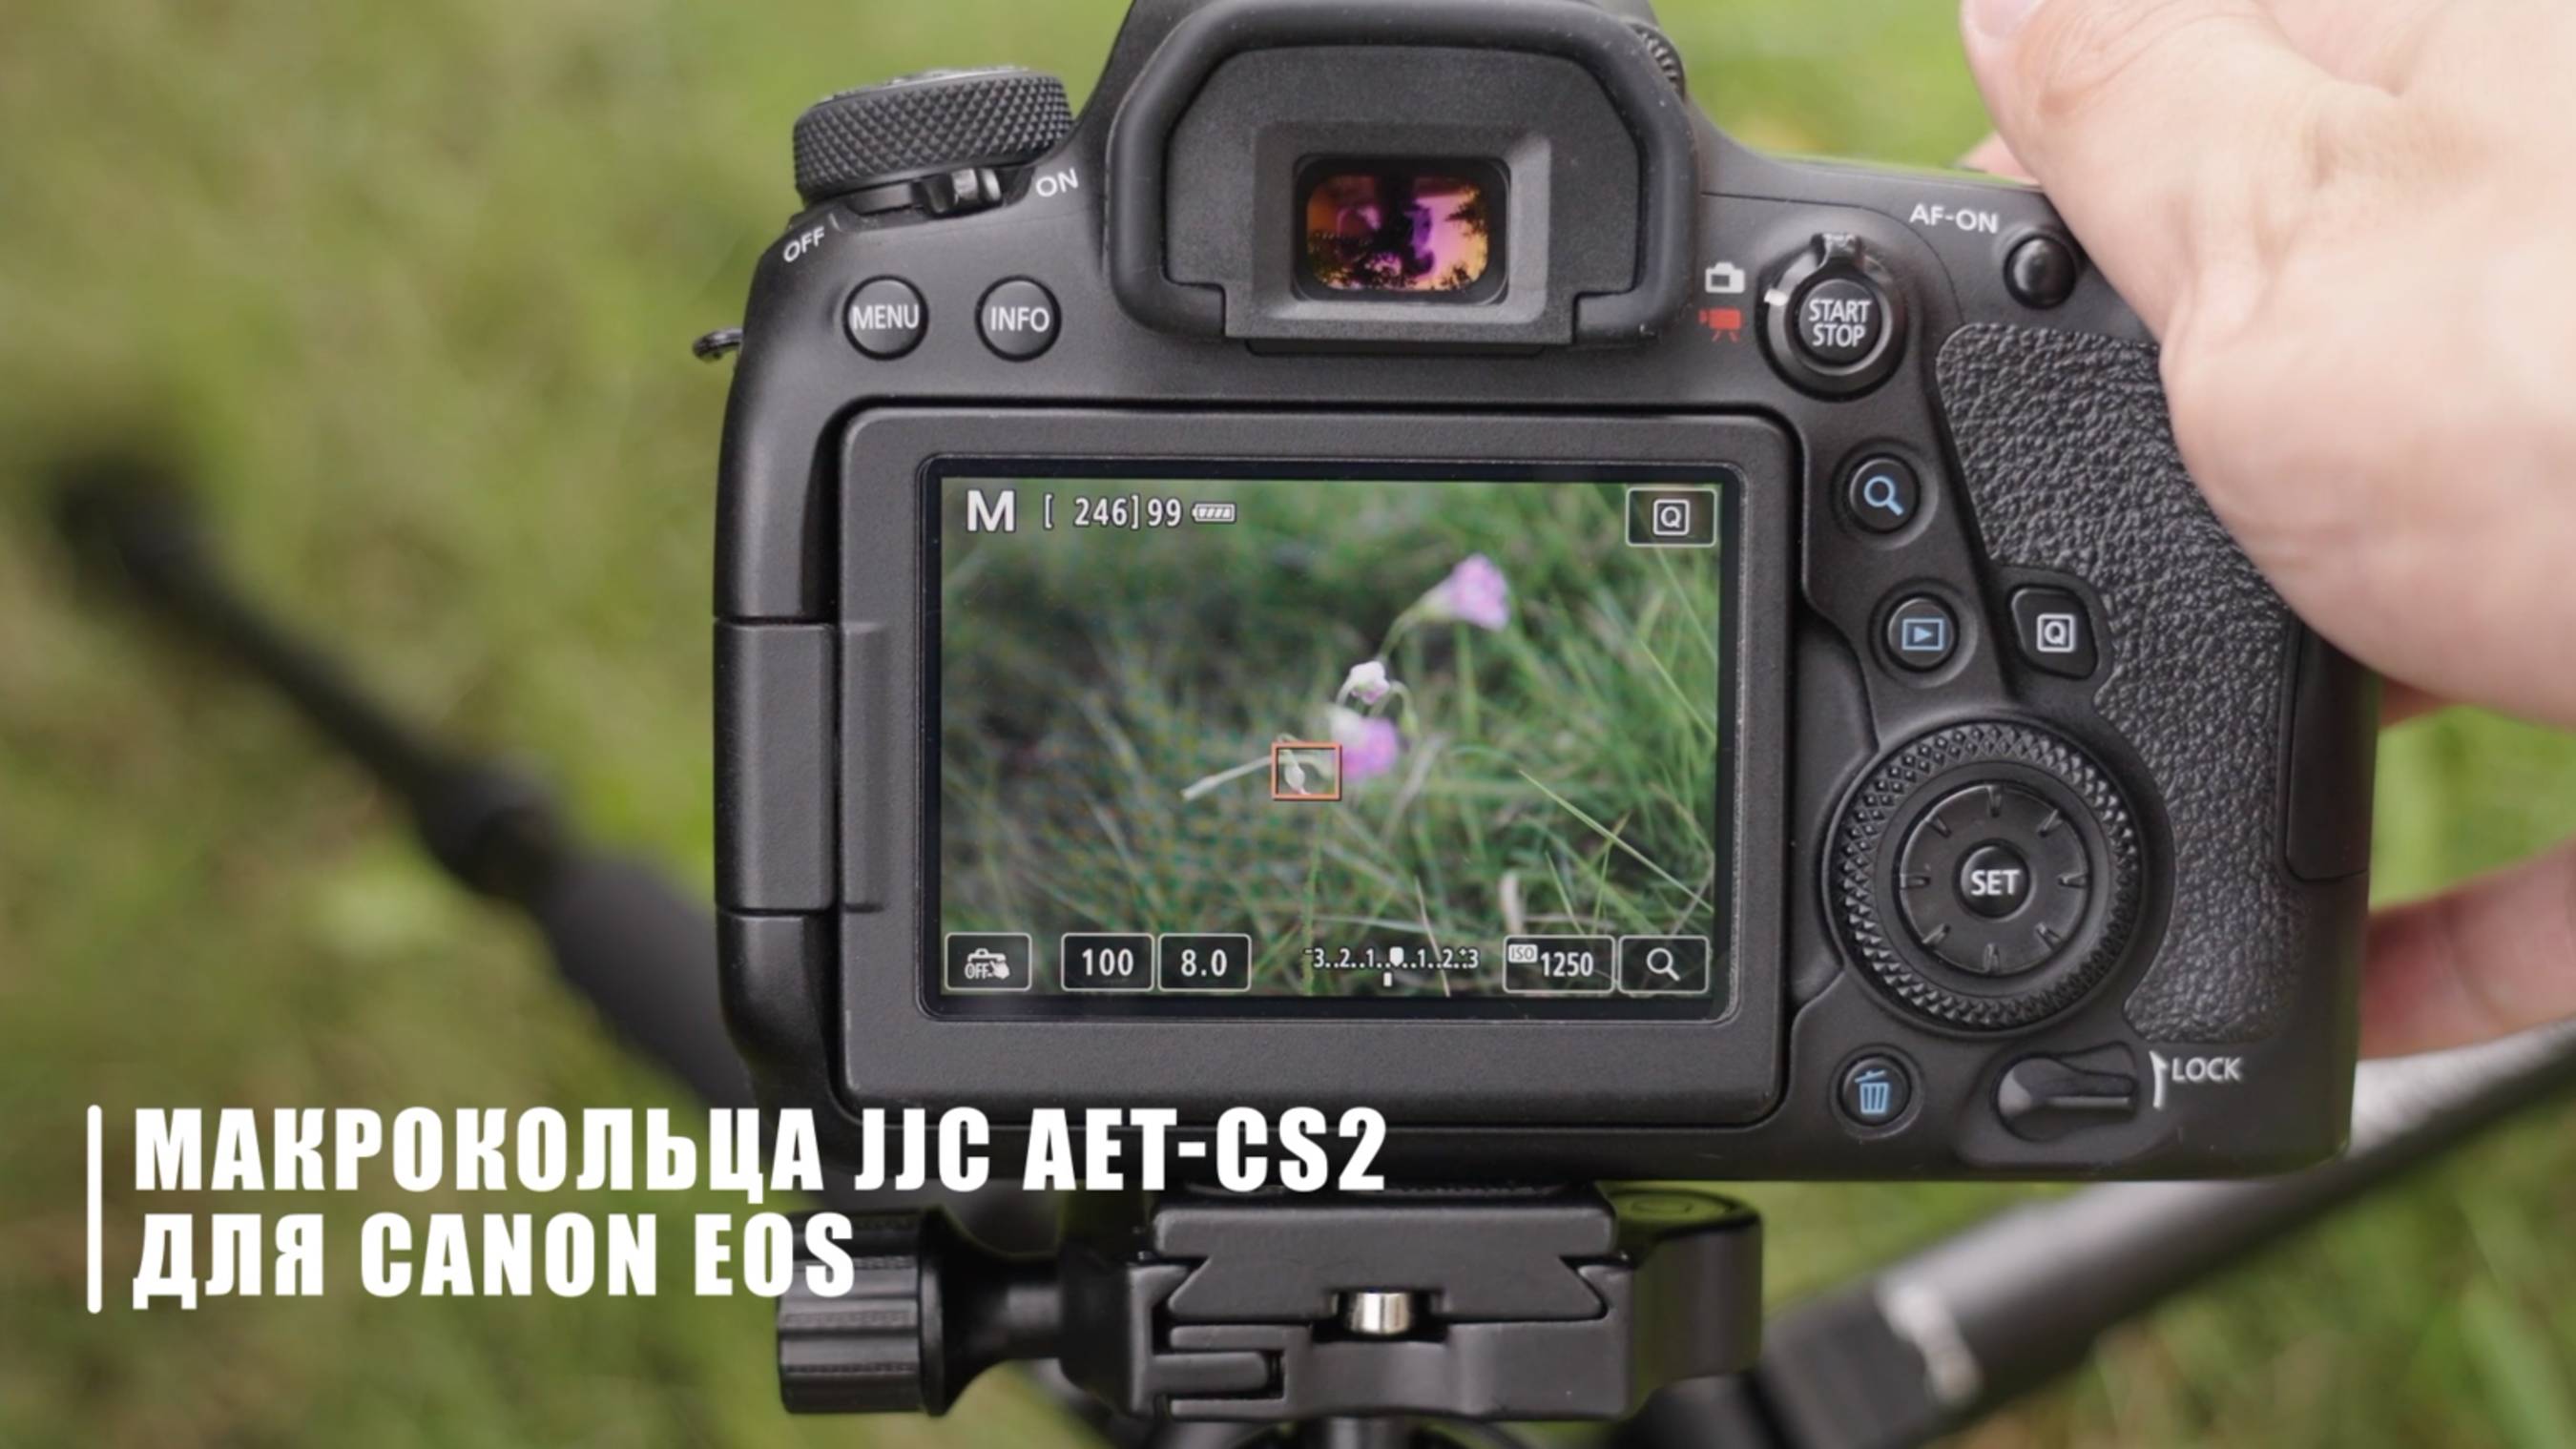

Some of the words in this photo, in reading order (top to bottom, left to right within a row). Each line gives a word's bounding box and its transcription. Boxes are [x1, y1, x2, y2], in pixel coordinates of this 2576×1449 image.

[1036, 167, 1079, 197] ON
[1909, 204, 1999, 234] AF-ON
[782, 225, 825, 263] OFF
[851, 304, 920, 332] MENU
[989, 305, 1050, 333] INFO
[1808, 299, 1870, 322] START
[1813, 323, 1866, 347] STOP
[966, 489, 1015, 531] M
[1970, 869, 2021, 897] SET
[1081, 947, 1134, 978] 100
[1180, 948, 1228, 978] 8.0
[1510, 945, 1535, 961] ISO
[1540, 951, 1594, 978] 1250
[2171, 1057, 2242, 1083] LOCK
